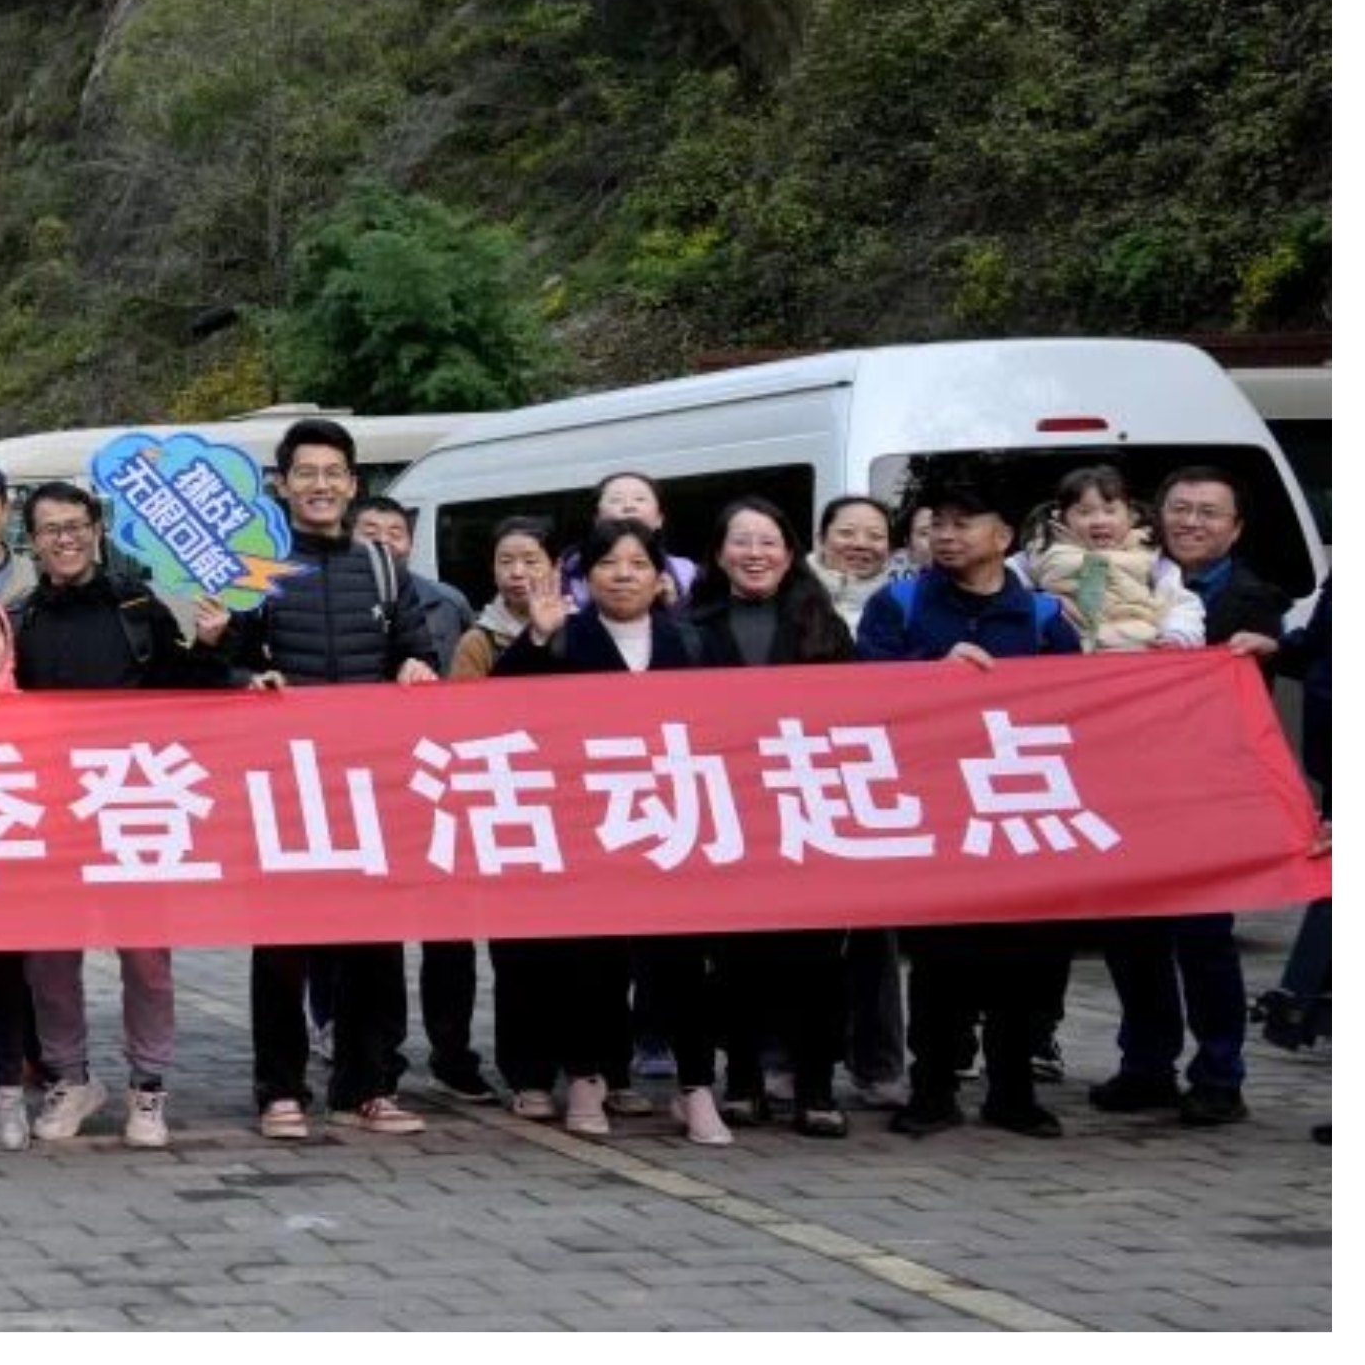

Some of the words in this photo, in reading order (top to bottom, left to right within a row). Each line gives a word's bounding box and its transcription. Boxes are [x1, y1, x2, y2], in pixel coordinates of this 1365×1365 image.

[112, 455, 242, 595] 无限可能
[173, 460, 252, 540] 挑战
